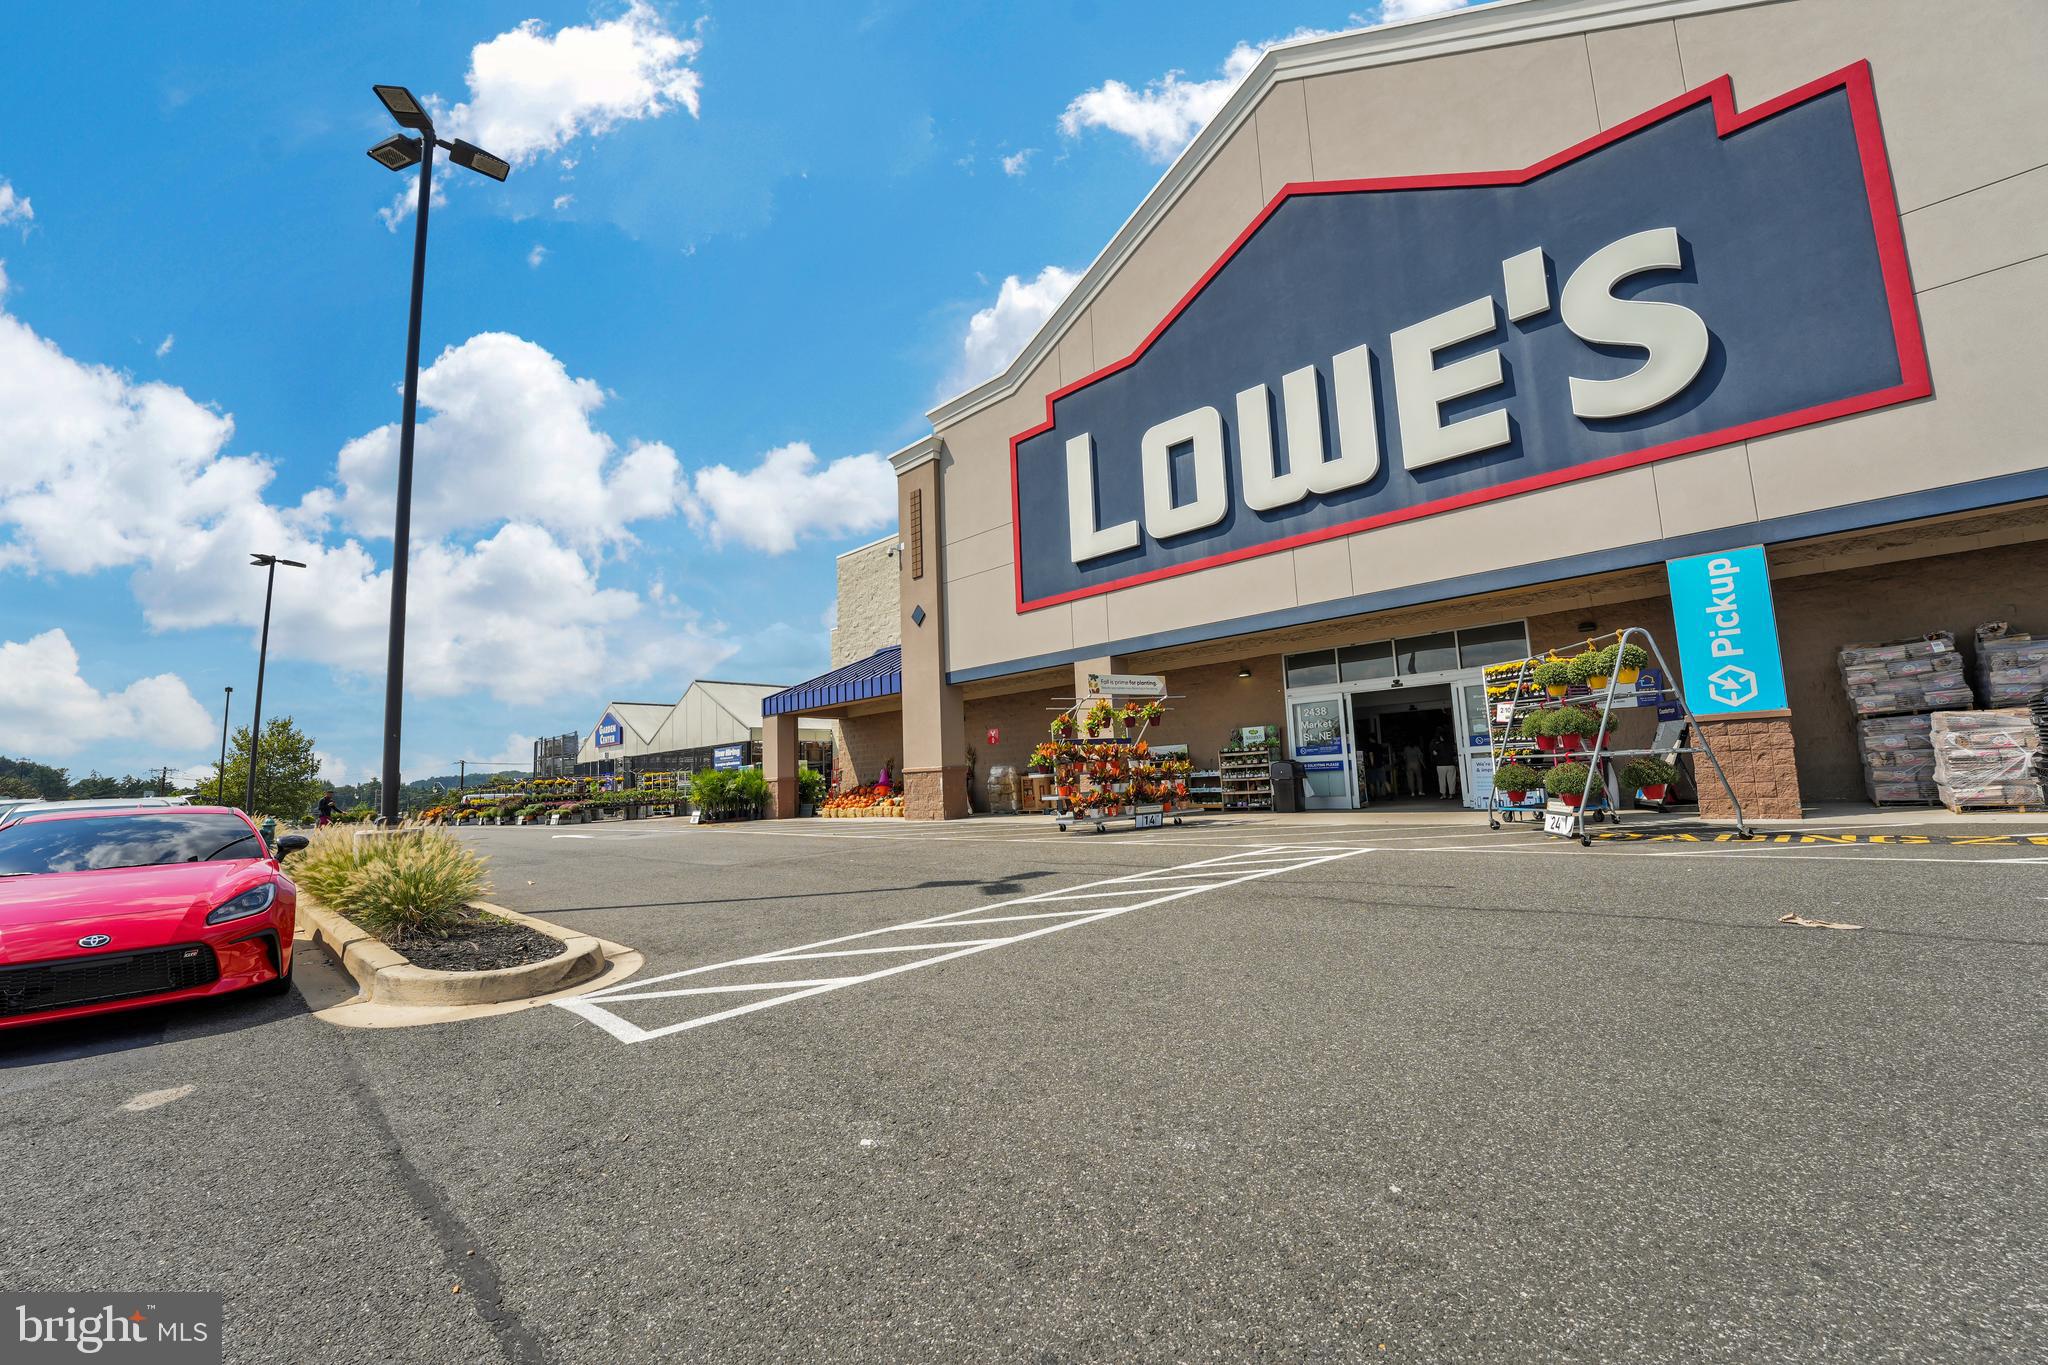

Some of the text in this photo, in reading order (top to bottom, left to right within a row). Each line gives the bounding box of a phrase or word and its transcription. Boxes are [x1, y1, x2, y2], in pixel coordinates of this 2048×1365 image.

[1065, 226, 1709, 564] LOWE'S
[1705, 557, 1745, 658] Pickup
[1303, 706, 1328, 717] 2438
[1300, 719, 1332, 729] Market
[1319, 731, 1332, 741] NE
[1144, 815, 1155, 825] 14
[1550, 816, 1560, 831] 24
